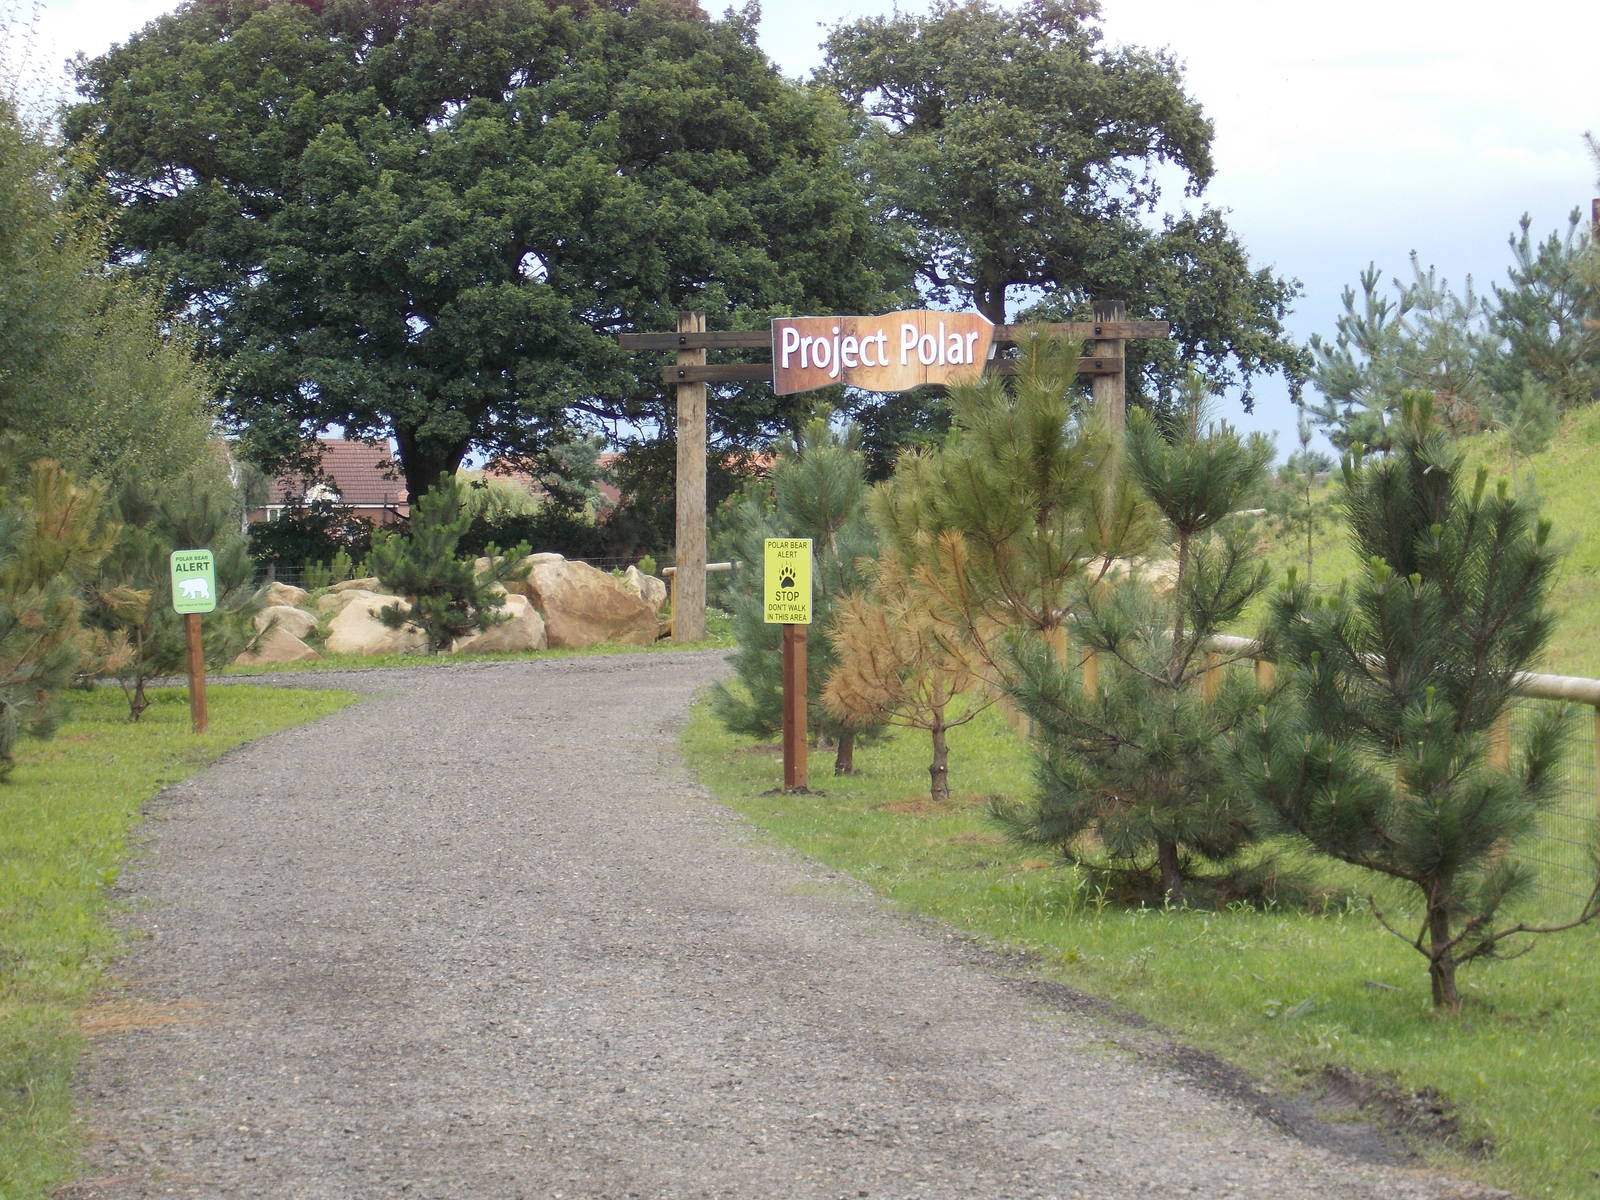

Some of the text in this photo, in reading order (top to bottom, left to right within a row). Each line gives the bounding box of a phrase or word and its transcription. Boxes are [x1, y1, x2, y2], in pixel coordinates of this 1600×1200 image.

[781, 321, 979, 379] Project Polar
[768, 541, 808, 549] POLAR BEAR
[175, 562, 210, 573] ALERT
[775, 591, 800, 602] STOP
[788, 604, 806, 612] WALK
